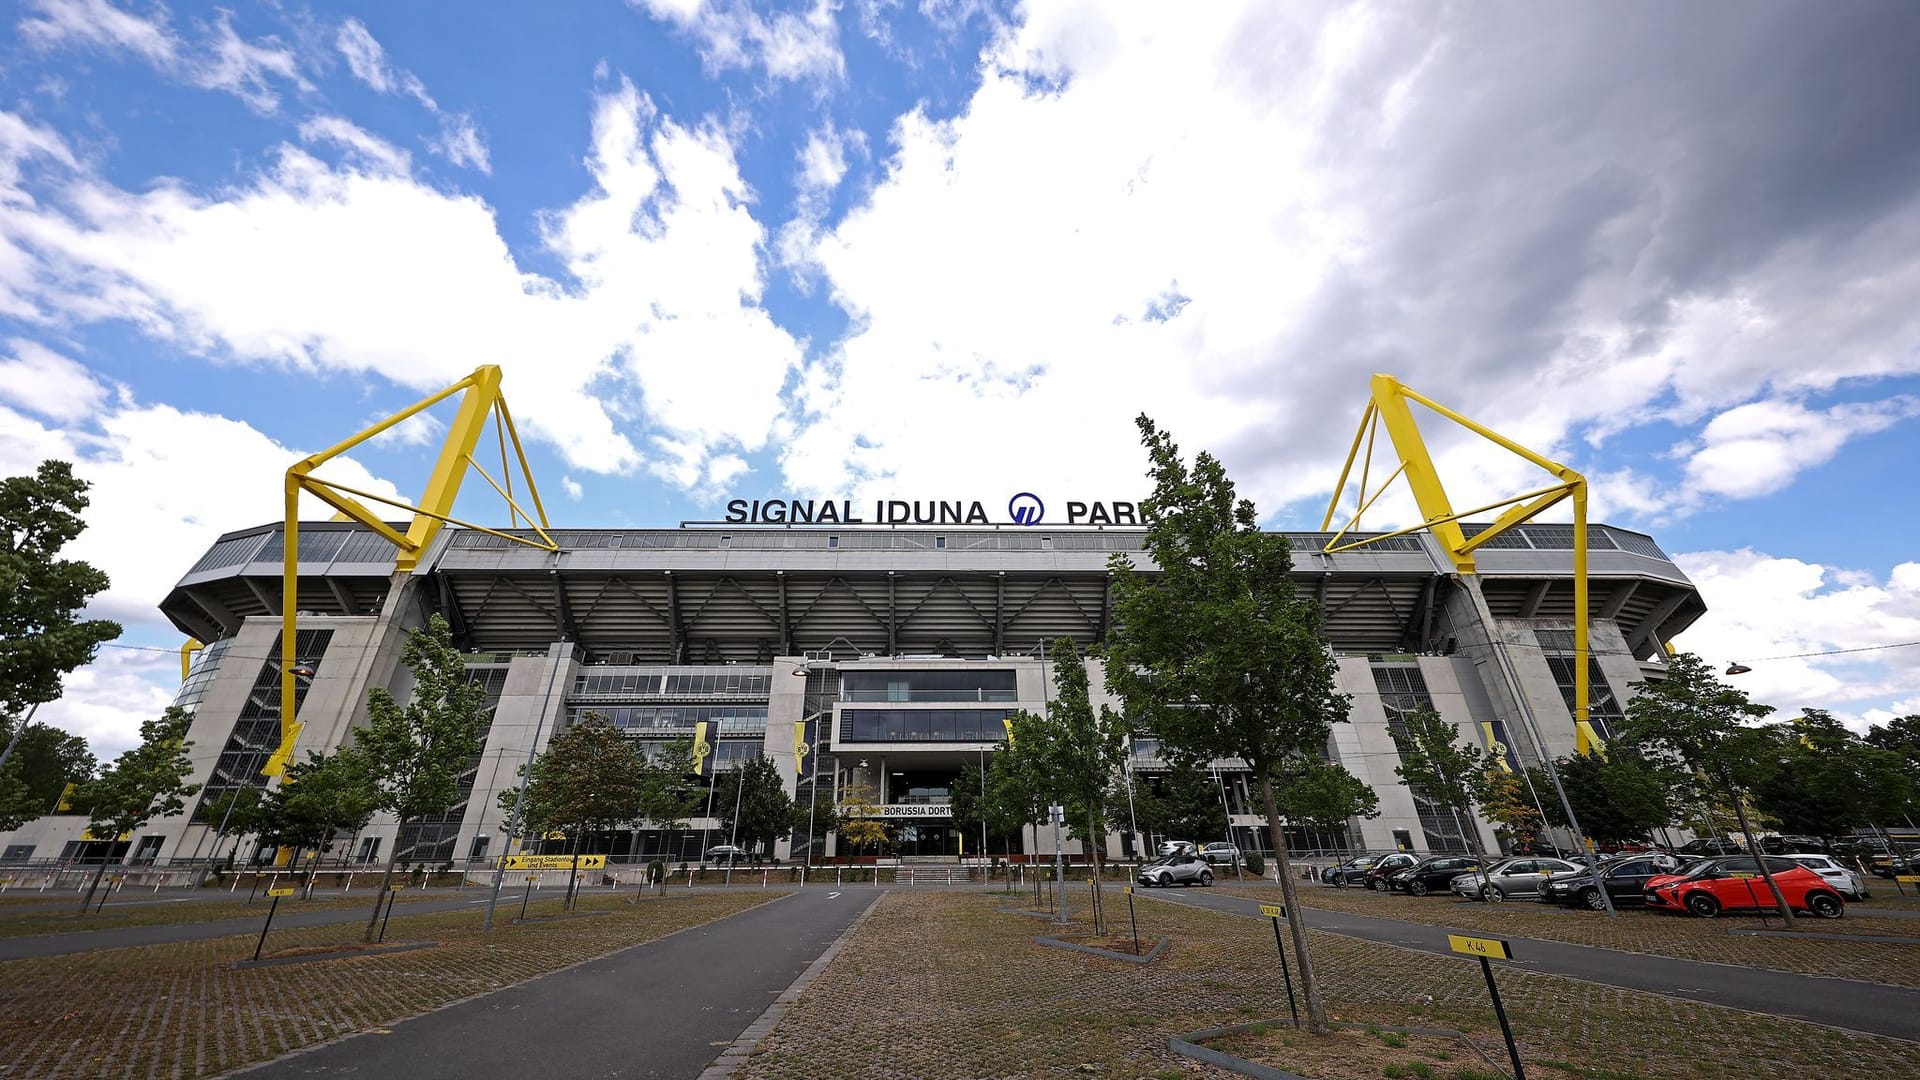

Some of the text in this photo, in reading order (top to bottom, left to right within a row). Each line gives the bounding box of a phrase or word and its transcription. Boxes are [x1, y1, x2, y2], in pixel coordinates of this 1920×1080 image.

[725, 500, 862, 523] SIGNAL
[876, 500, 989, 523] IDUNA
[885, 807, 953, 816] BORUSSIA DORT
[1466, 941, 1486, 952] K 46
